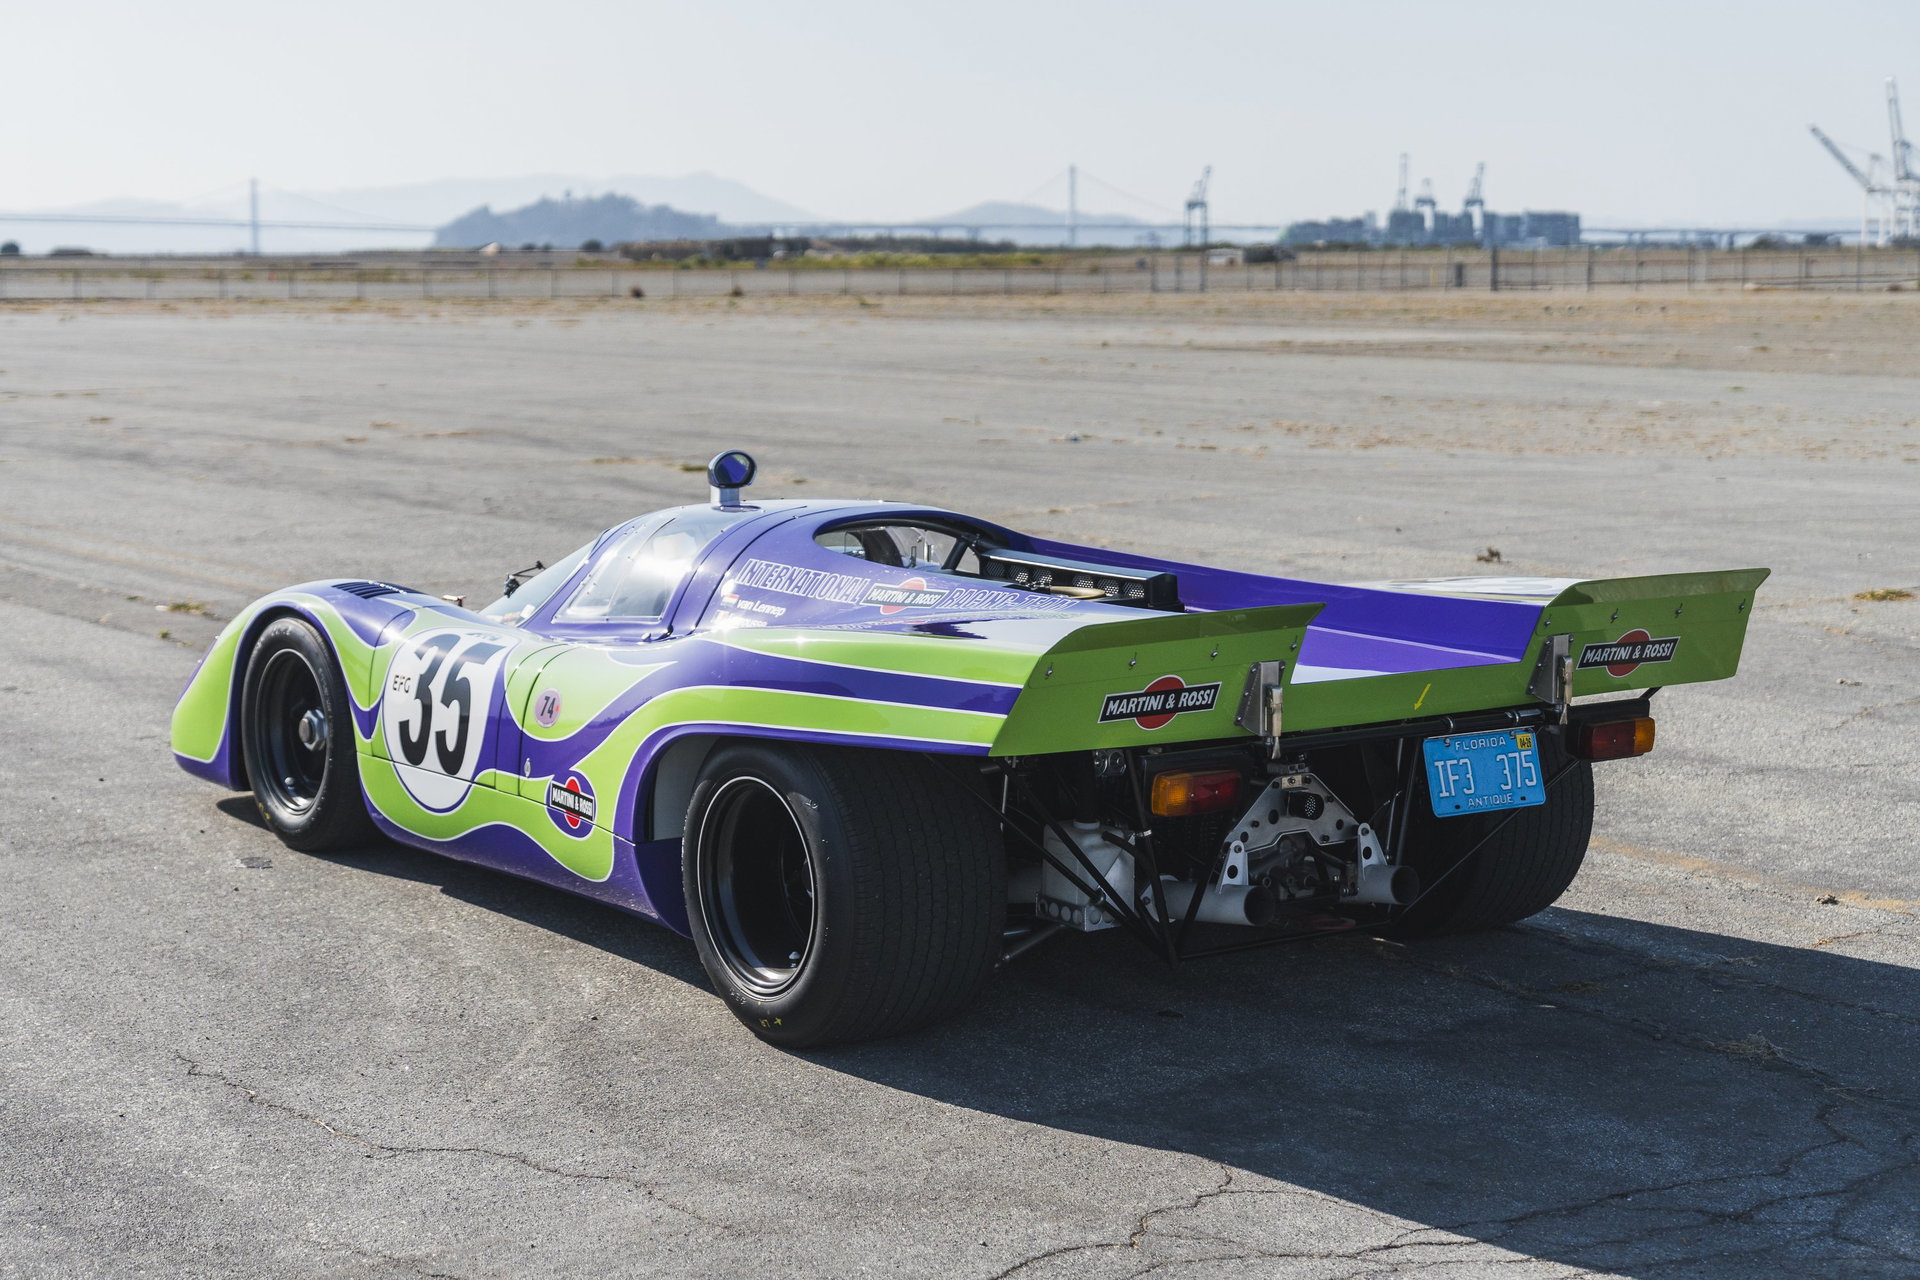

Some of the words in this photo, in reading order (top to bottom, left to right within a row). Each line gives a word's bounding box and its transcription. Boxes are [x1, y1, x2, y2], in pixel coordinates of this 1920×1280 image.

[735, 558, 871, 604] INTERNATIONAL
[868, 588, 904, 603] MARTINI
[905, 592, 914, 603] &
[914, 593, 942, 604] ROSSI
[936, 587, 1019, 609] RACING
[737, 600, 754, 610] van
[753, 601, 787, 617] Lennep
[1583, 645, 1633, 664] MARTINI
[1632, 645, 1642, 659] &
[1643, 642, 1673, 658] ROSSI
[392, 674, 411, 693] EFG
[398, 633, 507, 776] 35
[540, 695, 556, 719] 74
[1105, 694, 1165, 716] MARTINI
[1165, 693, 1176, 709] &
[1178, 688, 1215, 708] ROSSI
[1454, 736, 1507, 751] FLORIDA
[1434, 758, 1475, 798] IF3
[1496, 750, 1537, 790] 375
[552, 787, 575, 809] MARTINI
[580, 797, 593, 817] ROSSI
[1467, 792, 1514, 809] ANTIQUE
